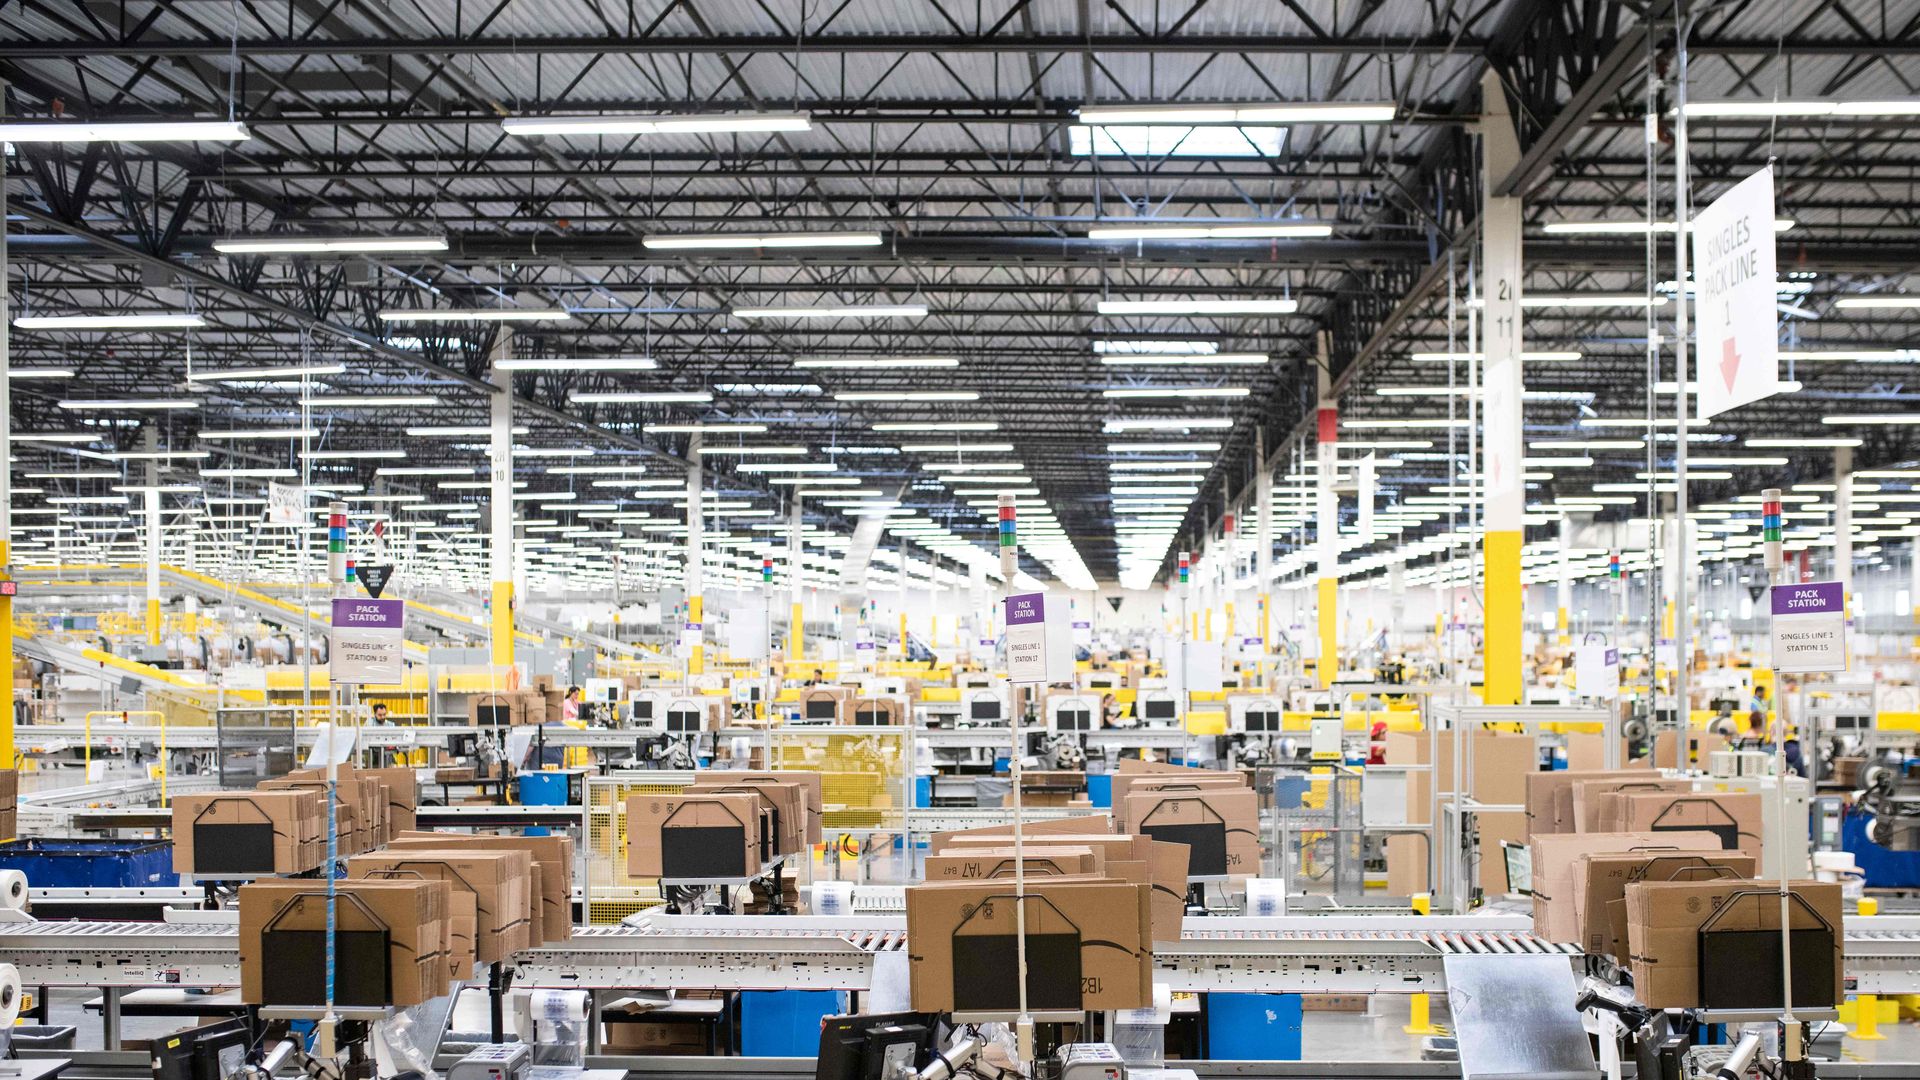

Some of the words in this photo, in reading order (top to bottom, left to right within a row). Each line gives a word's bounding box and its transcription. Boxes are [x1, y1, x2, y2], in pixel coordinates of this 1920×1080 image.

[1707, 215, 1750, 266] SINGLES
[1705, 265, 1727, 304] PACK
[1731, 248, 1757, 287] LINE
[1725, 300, 1731, 326] 1
[1497, 316, 1512, 338] 11
[496, 470, 504, 481] 10
[1795, 590, 1818, 598] PACK
[1018, 601, 1030, 609] PACK
[1788, 599, 1826, 608] STATION
[1014, 610, 1035, 618] STATION
[944, 867, 957, 875] B47
[962, 862, 982, 878] 1A7
[1608, 869, 1622, 877] B47
[1081, 977, 1103, 994] 1B2
